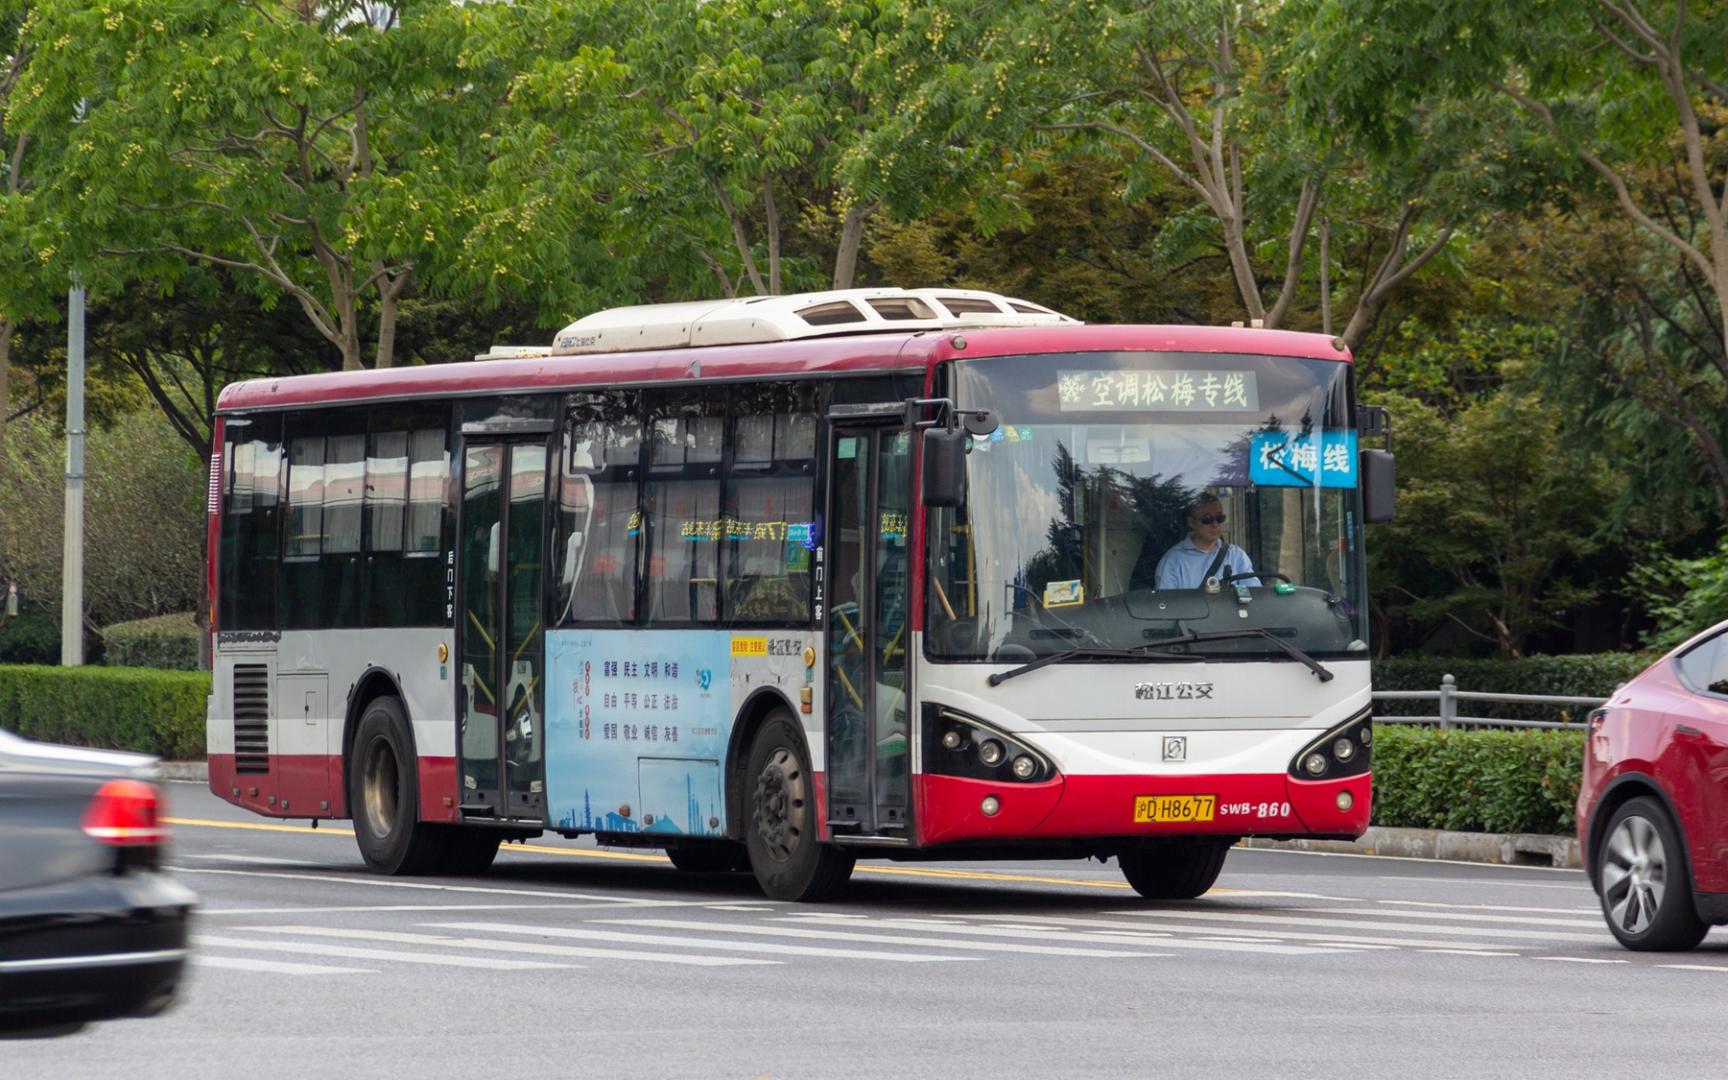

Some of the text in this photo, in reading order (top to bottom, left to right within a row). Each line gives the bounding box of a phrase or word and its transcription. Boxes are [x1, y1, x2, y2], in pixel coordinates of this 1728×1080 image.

[1091, 372, 1247, 407] 空调松梅专线
[1259, 441, 1350, 473] 松梅线
[624, 661, 638, 677] 民主
[644, 661, 658, 678] 文明
[1135, 681, 1214, 700] 松江公交
[604, 692, 617, 708] 自由
[624, 692, 638, 710] 平等
[644, 694, 658, 709] 公正
[1219, 802, 1291, 818] SWB-860
